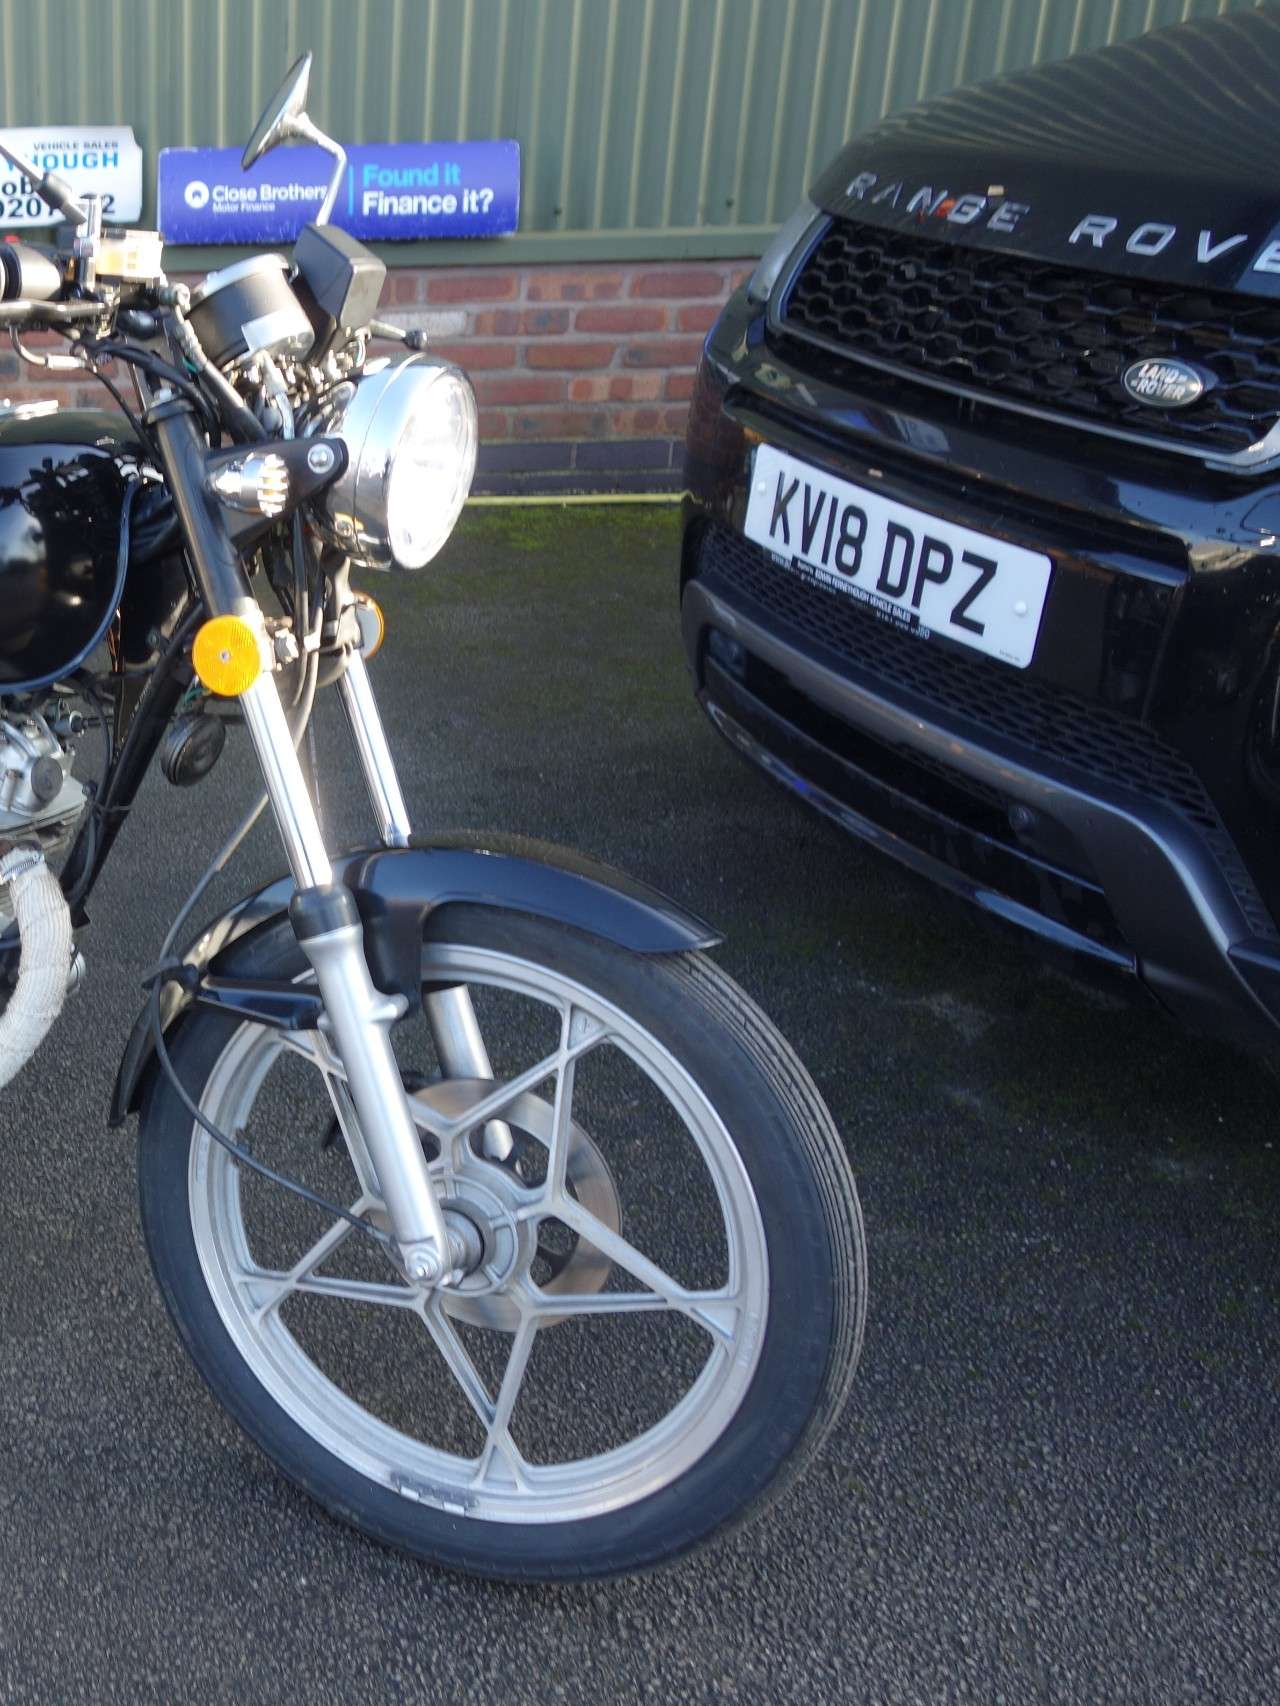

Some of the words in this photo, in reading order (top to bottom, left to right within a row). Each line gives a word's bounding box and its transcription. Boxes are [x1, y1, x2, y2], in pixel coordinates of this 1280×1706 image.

[33, 142, 80, 151] VEHICLE
[362, 163, 439, 188] Found
[444, 162, 462, 186] it
[212, 185, 258, 201] Close
[362, 191, 458, 216] Finance
[463, 187, 495, 214] it?
[845, 171, 1031, 234] RANGE
[212, 202, 239, 213] Motor
[241, 202, 276, 213] Finance
[1138, 363, 1180, 384] LAND
[1136, 378, 1186, 400] ROVER
[770, 471, 868, 577] KV18
[876, 519, 999, 637] DPZ
